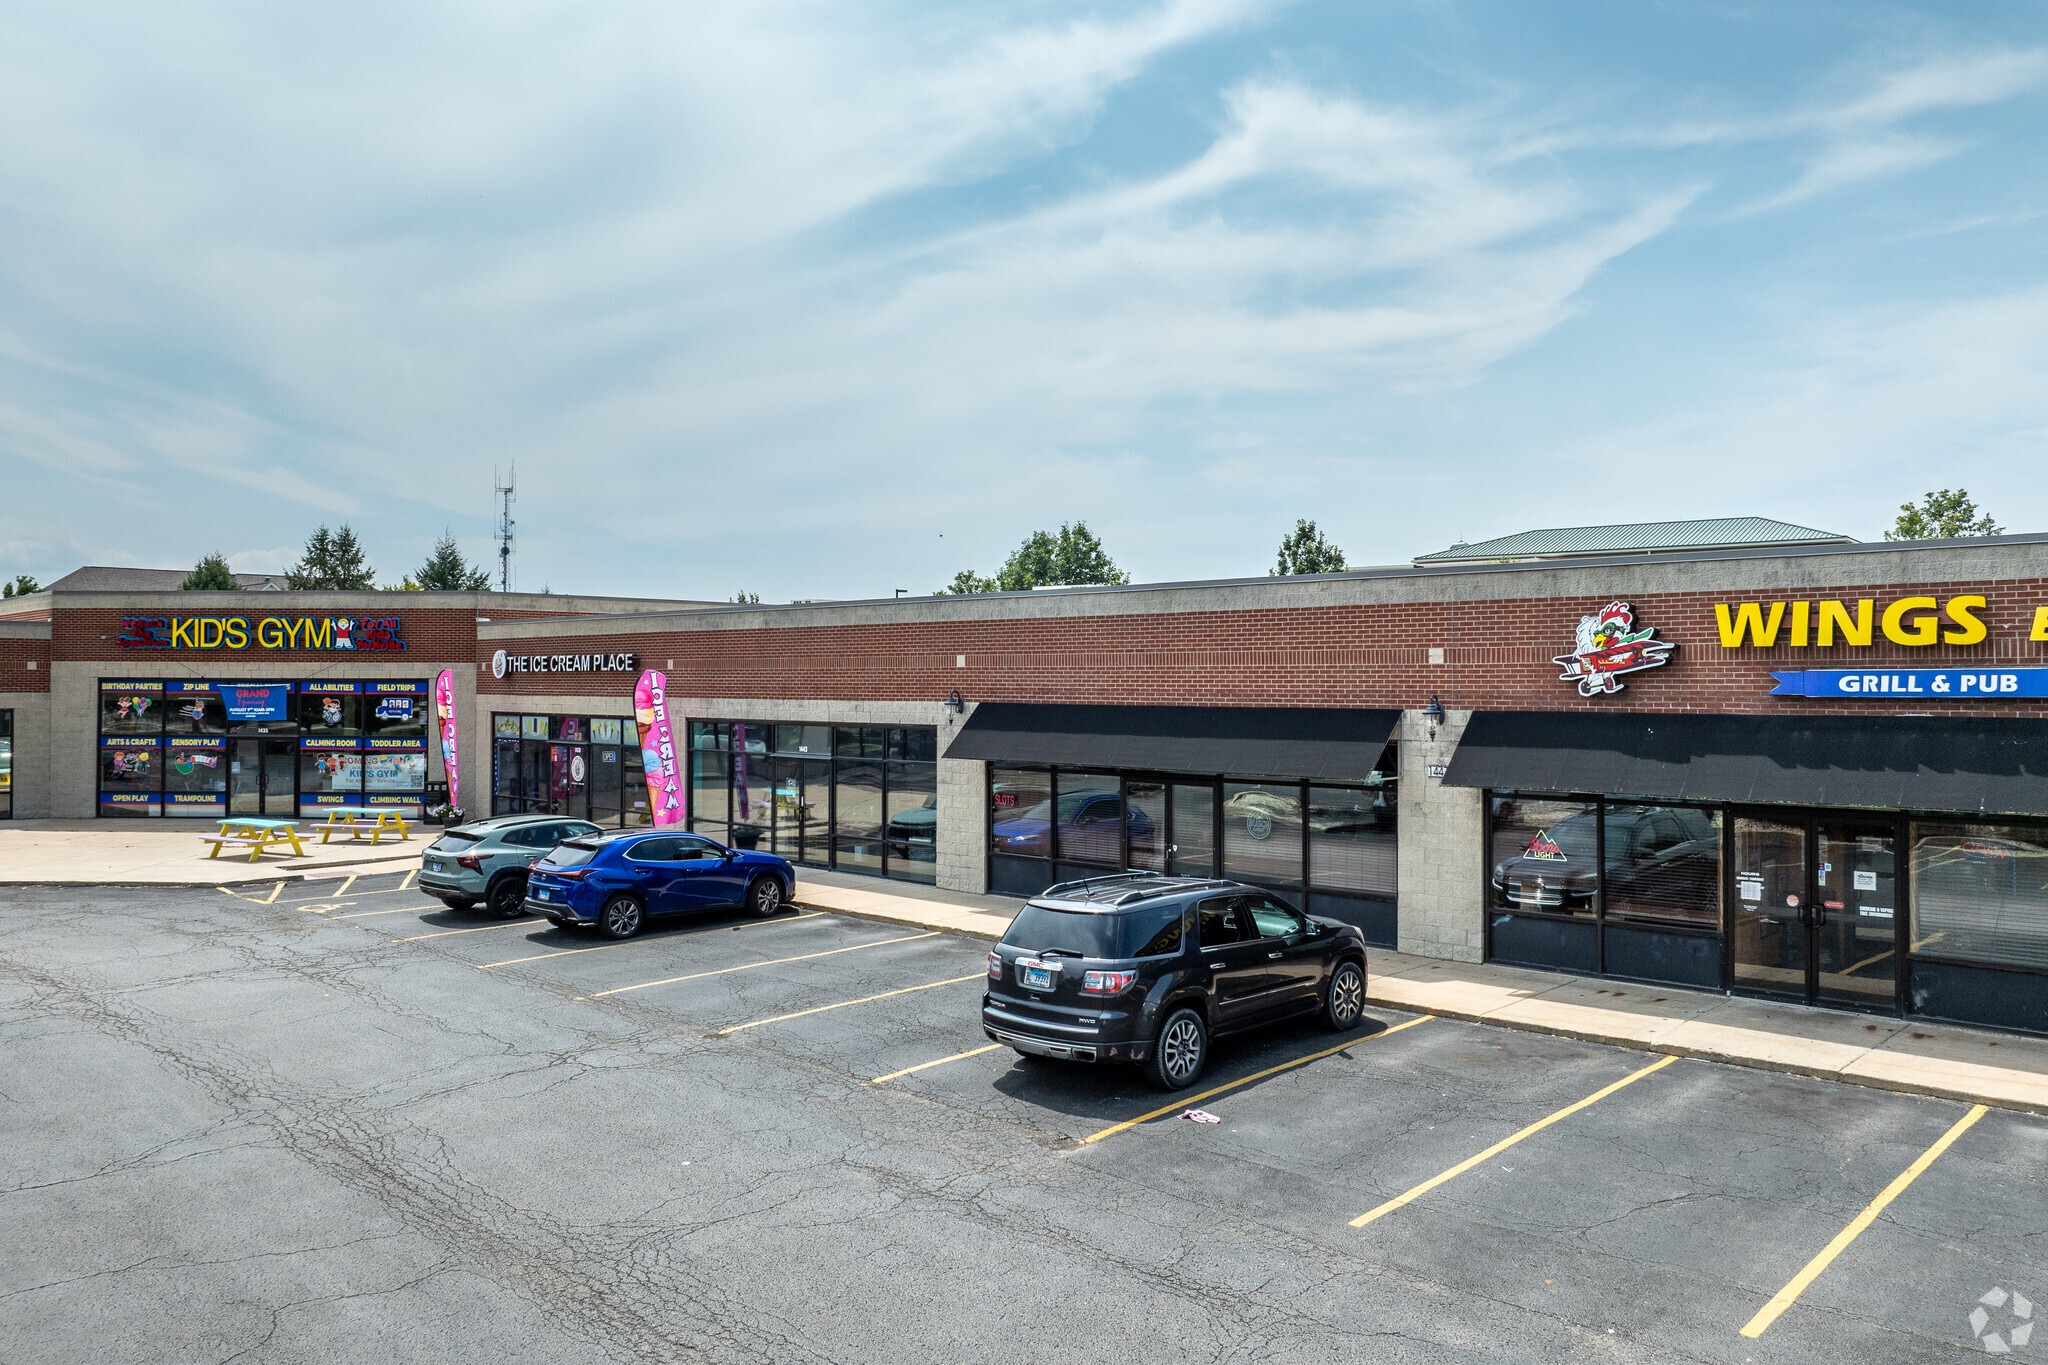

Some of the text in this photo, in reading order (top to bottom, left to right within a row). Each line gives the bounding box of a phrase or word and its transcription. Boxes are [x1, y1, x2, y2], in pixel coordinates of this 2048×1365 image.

[361, 619, 397, 629] For All
[1714, 595, 1988, 648] WINGS
[172, 617, 331, 648] KID'S GYM
[507, 653, 633, 672] THE ICE CREAM PLACE
[1838, 674, 2018, 692] GRILL & PUB
[236, 689, 270, 697] GRAND
[107, 738, 125, 746] ARTS
[131, 738, 156, 746] CRAFTS
[306, 739, 356, 747] CALMING ROOM
[994, 793, 1015, 806] SLOTS
[1529, 838, 1560, 853] Coors
[1534, 850, 1555, 859] LIGHT
